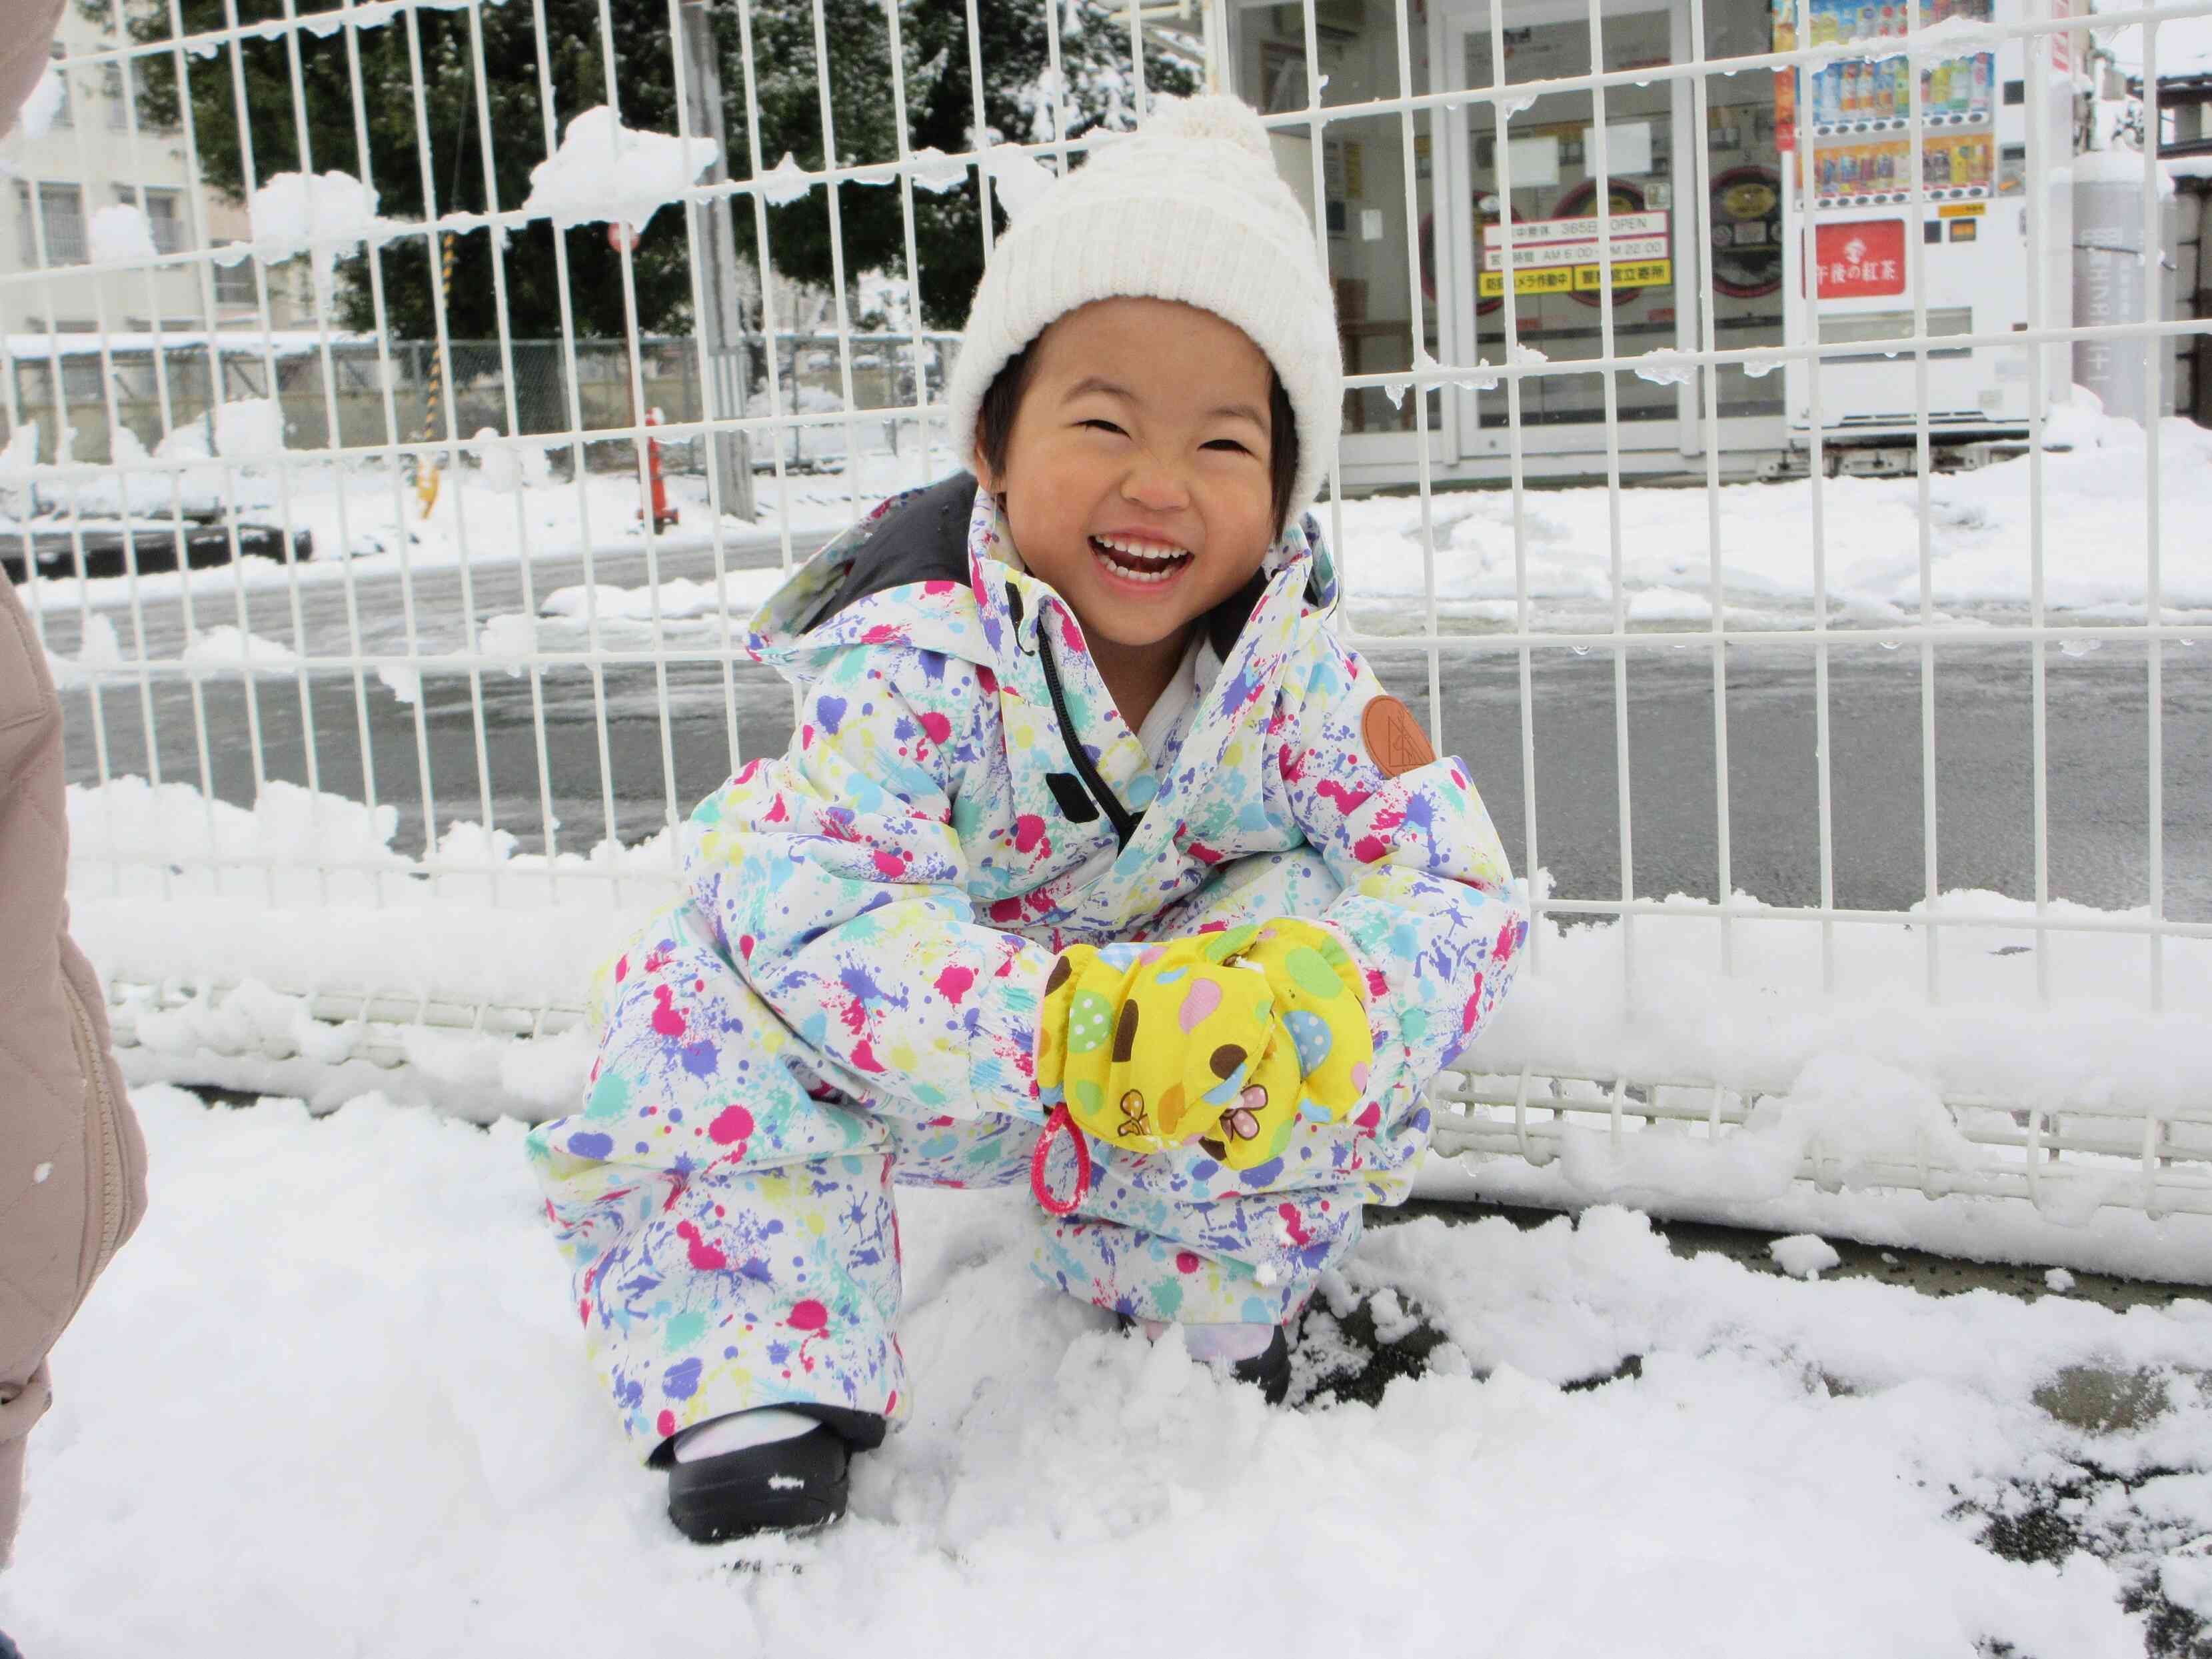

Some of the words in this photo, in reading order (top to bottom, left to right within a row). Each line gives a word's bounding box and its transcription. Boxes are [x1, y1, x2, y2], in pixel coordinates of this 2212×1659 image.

[1610, 217, 1648, 231] OPEN
[1490, 250, 1534, 266] 営時間
[1486, 273, 1568, 291] 防犯メラ作動中
